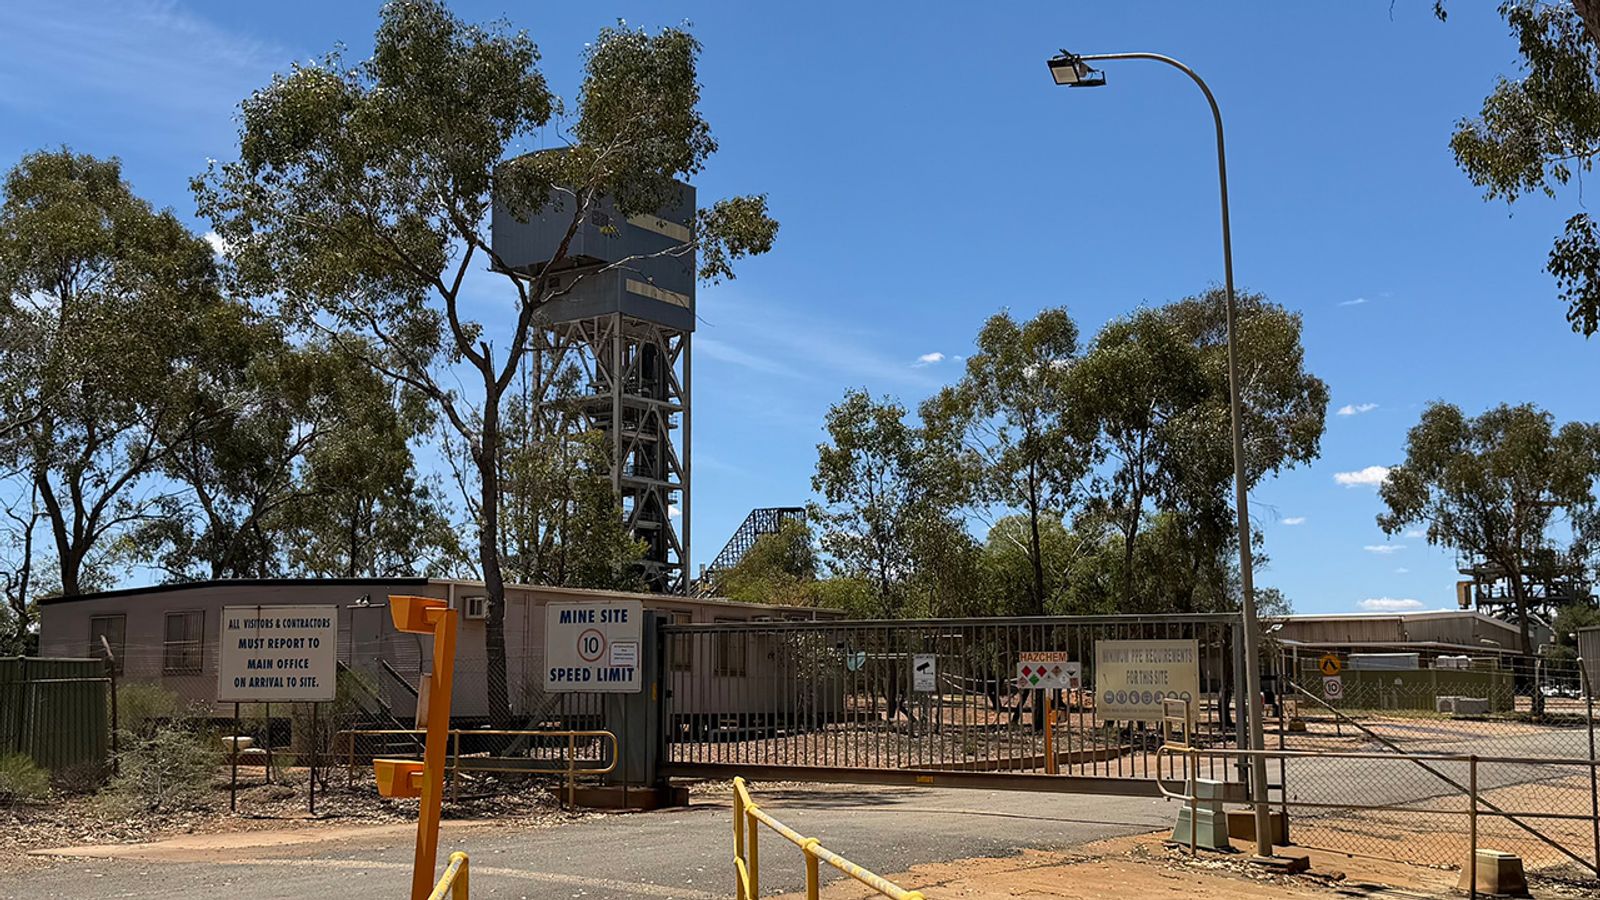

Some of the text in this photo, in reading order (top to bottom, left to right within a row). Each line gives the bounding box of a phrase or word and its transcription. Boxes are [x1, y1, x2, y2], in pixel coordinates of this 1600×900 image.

[559, 609, 628, 624] MINE SITE
[228, 618, 330, 629] ALL VISITORS & CONTRACTORS
[238, 638, 320, 649] MUST REPORT TO
[584, 637, 599, 654] 10
[1020, 652, 1066, 662] HAZCHEM
[247, 659, 309, 669] MAIN OFFICE
[550, 667, 634, 682] SPEED LIMIT
[1126, 670, 1168, 685] FOR THIS SITE
[234, 677, 319, 687] ON ARRIVAL TO SITE.
